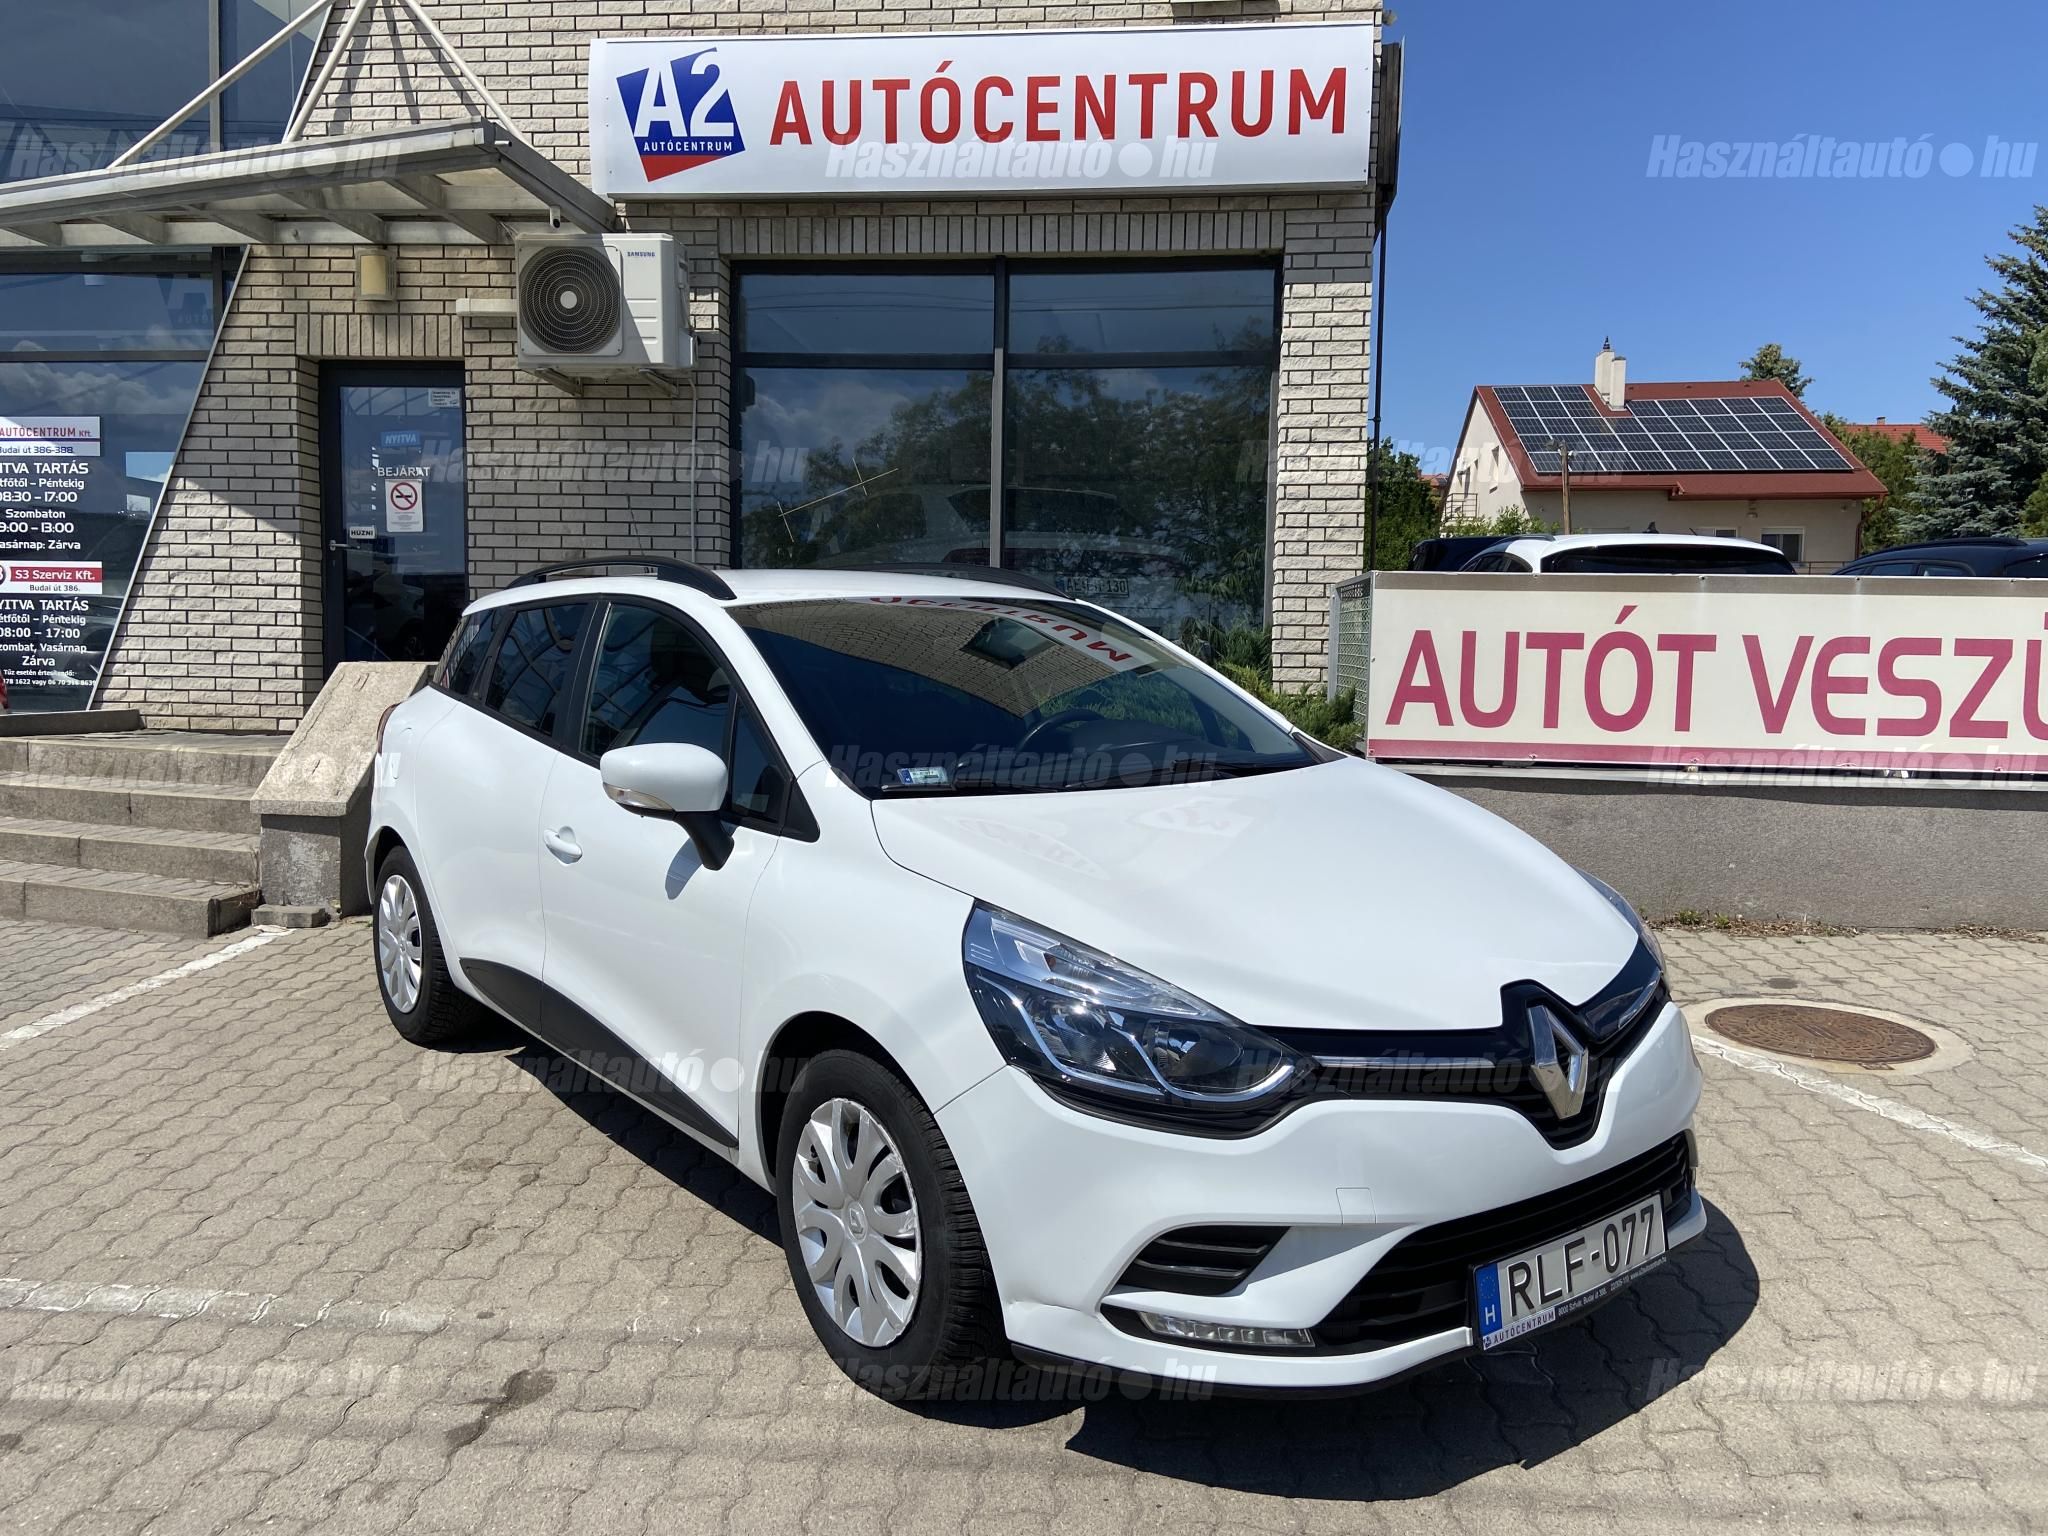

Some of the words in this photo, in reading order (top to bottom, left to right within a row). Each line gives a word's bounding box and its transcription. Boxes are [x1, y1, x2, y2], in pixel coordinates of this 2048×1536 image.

[633, 48, 735, 138] A2
[769, 60, 1347, 146] AUTÓCENTRUM
[643, 139, 733, 152] AUTÓCENTRUM
[33, 460, 89, 474] TARTÁS
[378, 465, 431, 477] BEJÁRAT
[38, 478, 84, 490] Péntekig
[0, 491, 31, 502] 8:30
[44, 491, 78, 502] 17:00
[5, 508, 66, 519] Szombaton
[41, 521, 75, 533] 13:00
[48, 539, 81, 550] Zárva
[15, 569, 30, 579] S3
[32, 569, 72, 580] Szerviz
[75, 570, 96, 580] Kft.
[29, 584, 51, 592] Budai
[53, 584, 62, 592] út
[39, 597, 90, 612] TARTÁS
[42, 614, 87, 627] Péntekig
[45, 628, 80, 639] 17:00
[40, 643, 87, 655] Vasárnap
[21, 655, 56, 667] Zárva
[1385, 605, 1717, 733] AUTÓT
[32, 680, 47, 688] vagy
[1506, 1203, 1655, 1318] RLF-077
[1484, 1303, 1496, 1326] H
[1493, 1308, 1555, 1343] AUTÓCENTRUM
